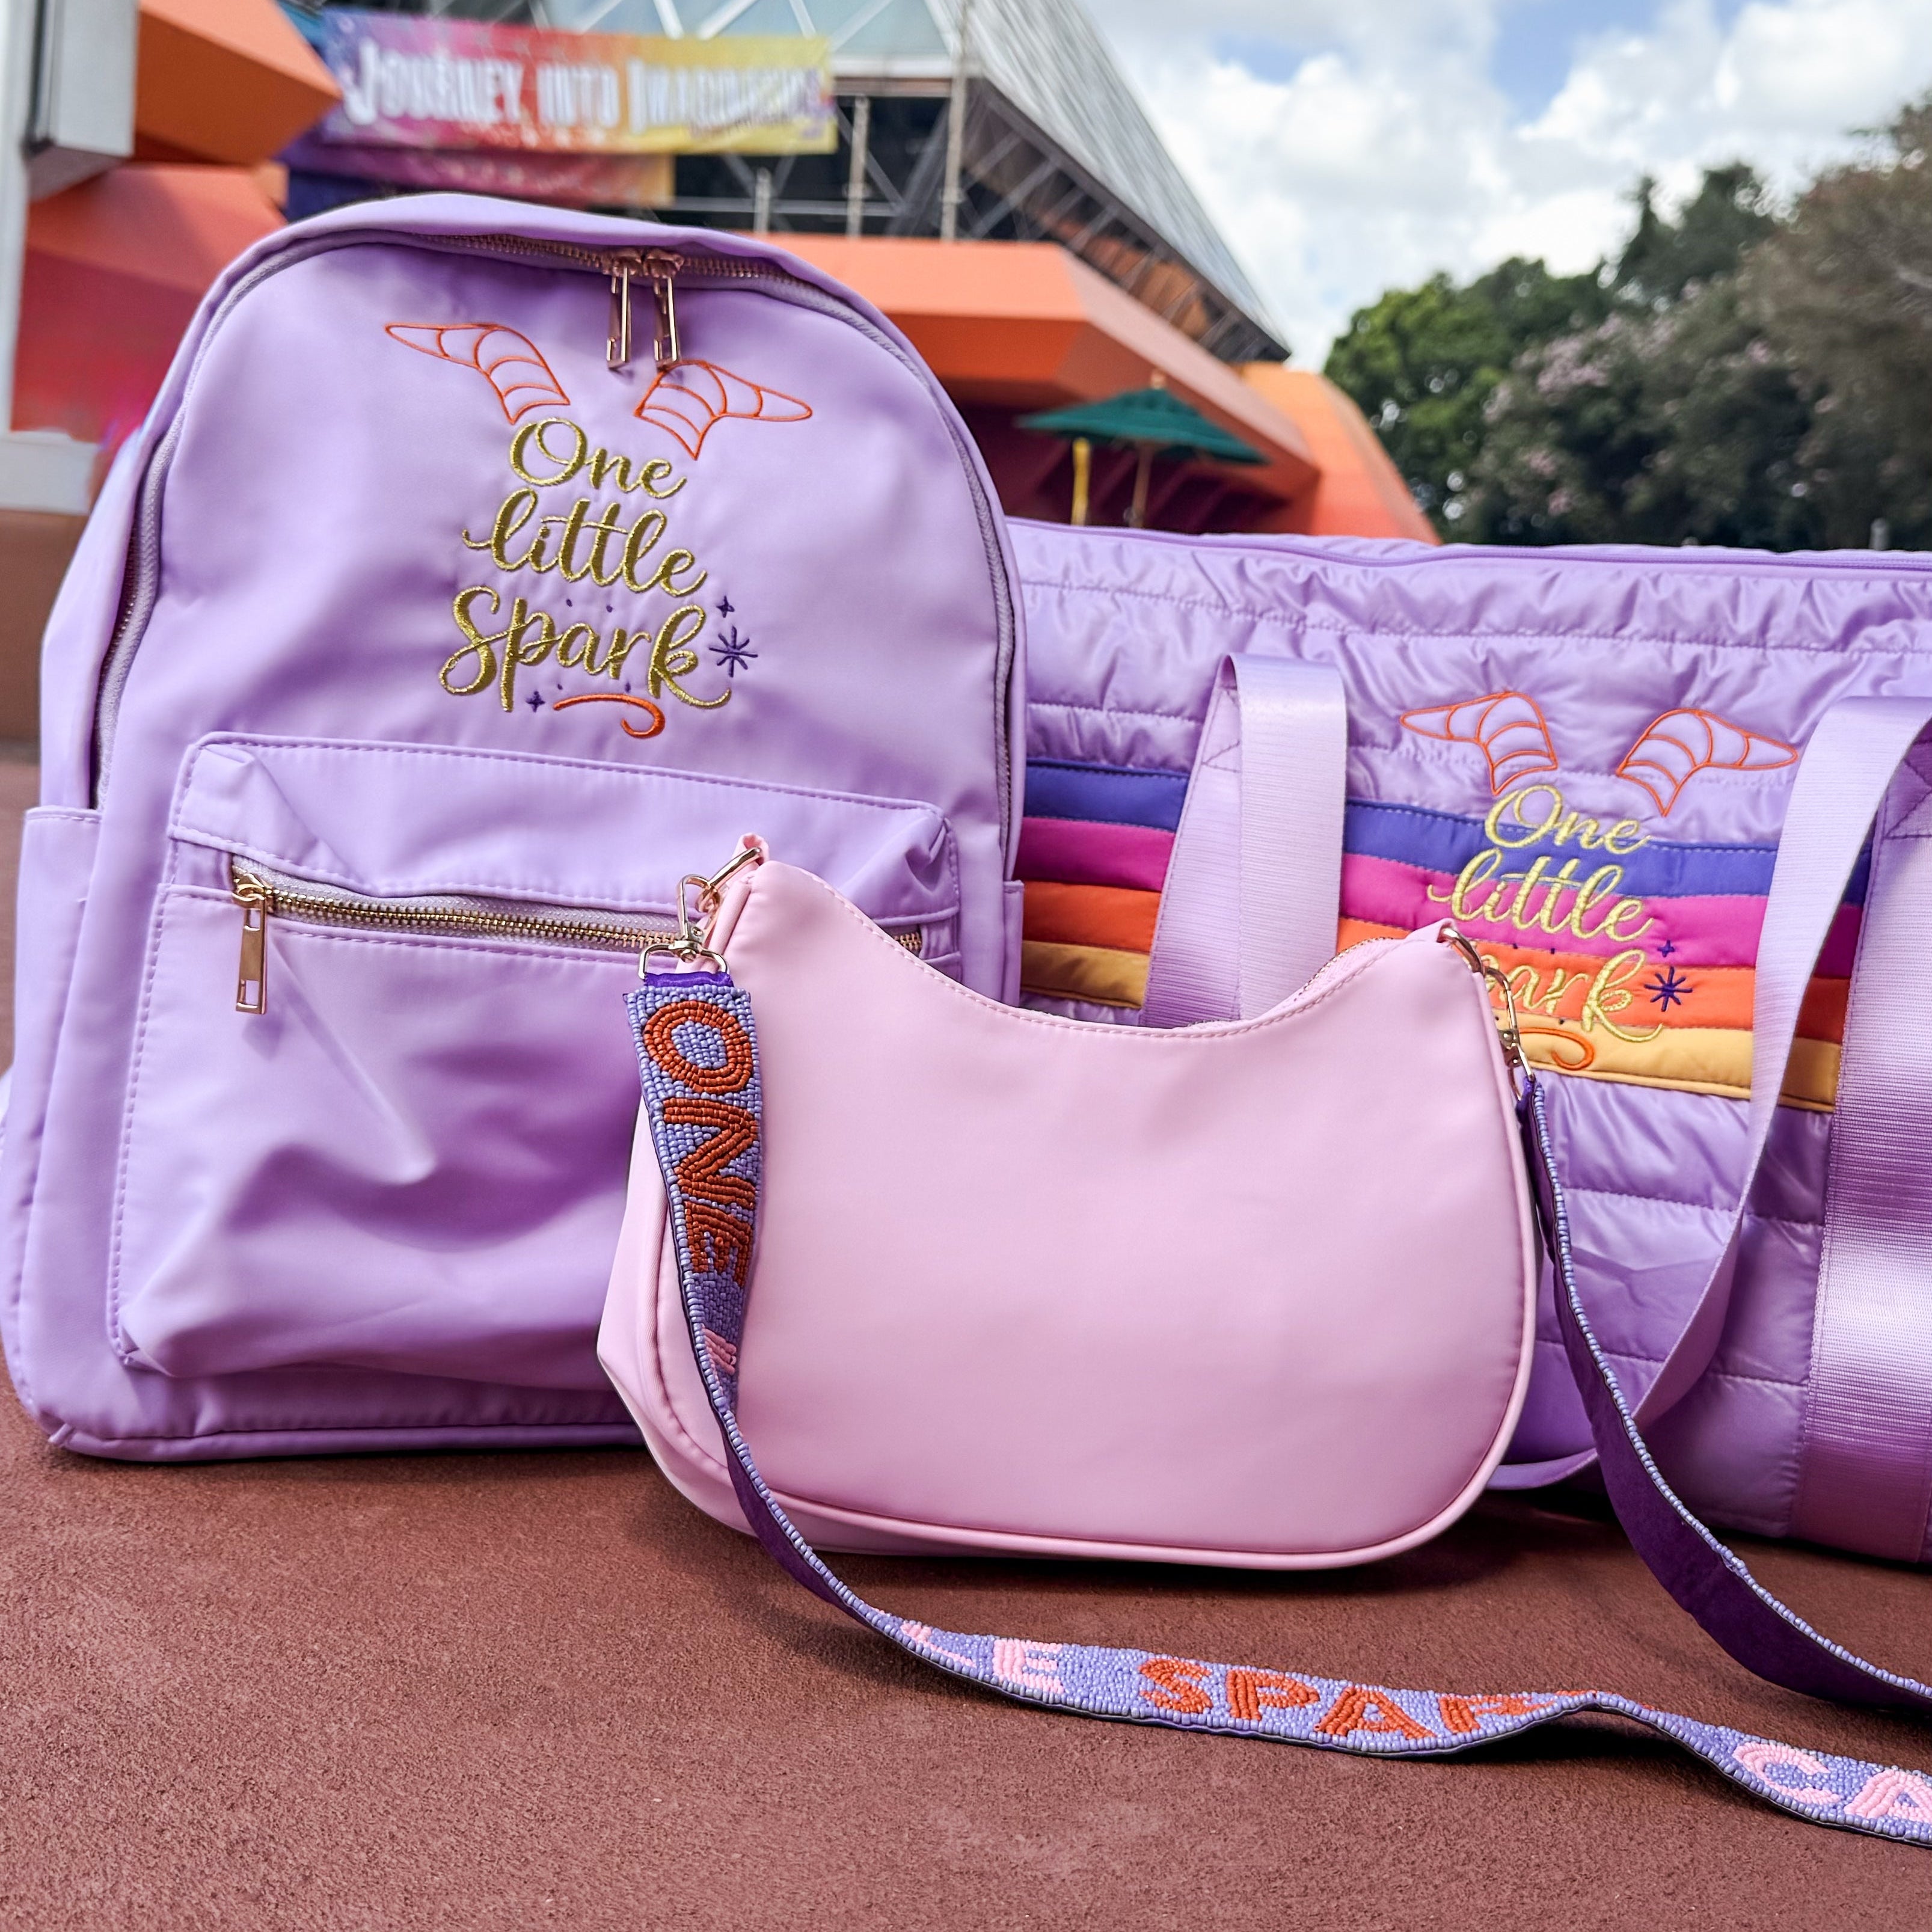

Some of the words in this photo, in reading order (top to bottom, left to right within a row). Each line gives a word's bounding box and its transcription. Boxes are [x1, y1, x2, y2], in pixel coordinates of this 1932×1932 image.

[511, 417, 687, 498] One
[462, 488, 708, 598] little
[439, 586, 732, 713] Spark
[1485, 784, 1652, 854] One
[1427, 848, 1655, 942] little
[1481, 949, 1664, 1043] ark
[643, 1000, 759, 1288] ONE
[1136, 1656, 1605, 1739] SPAR
